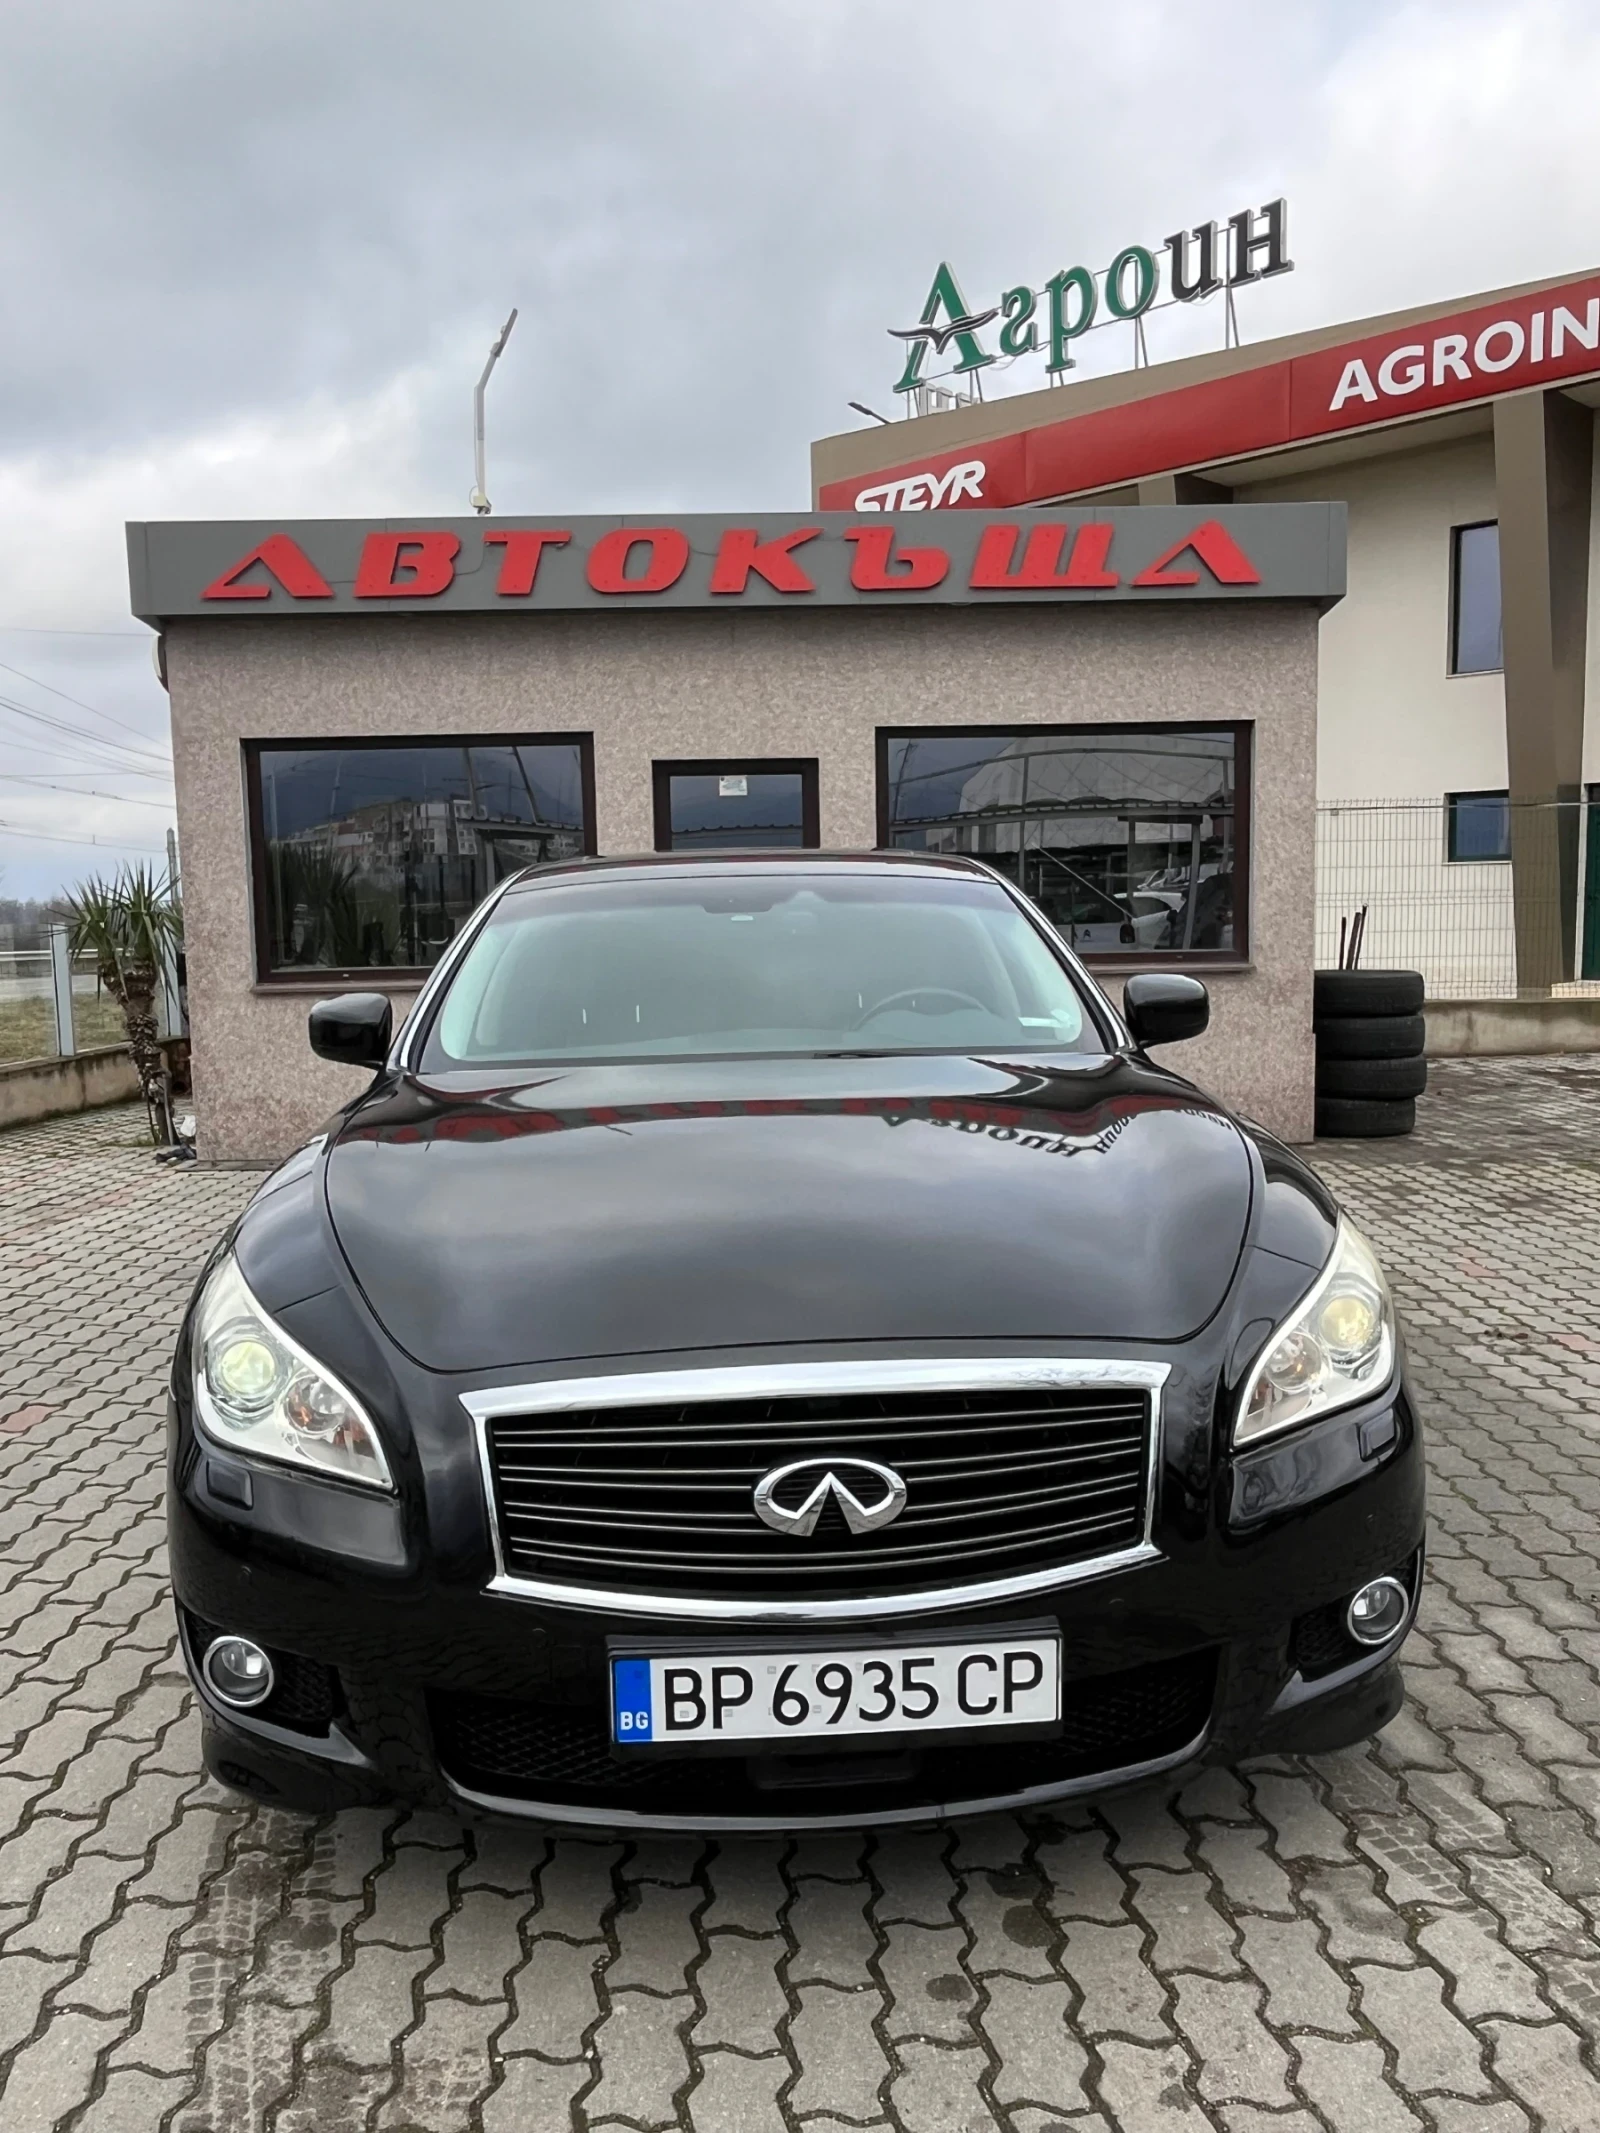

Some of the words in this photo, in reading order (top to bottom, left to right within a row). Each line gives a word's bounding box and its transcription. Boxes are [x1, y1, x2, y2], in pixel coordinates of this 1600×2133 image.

[888, 197, 1295, 393] Агроин
[1328, 297, 1600, 411] AGROIN
[854, 460, 986, 512] STEYR
[620, 1711, 649, 1730] BG
[772, 1657, 939, 1725] 6935
